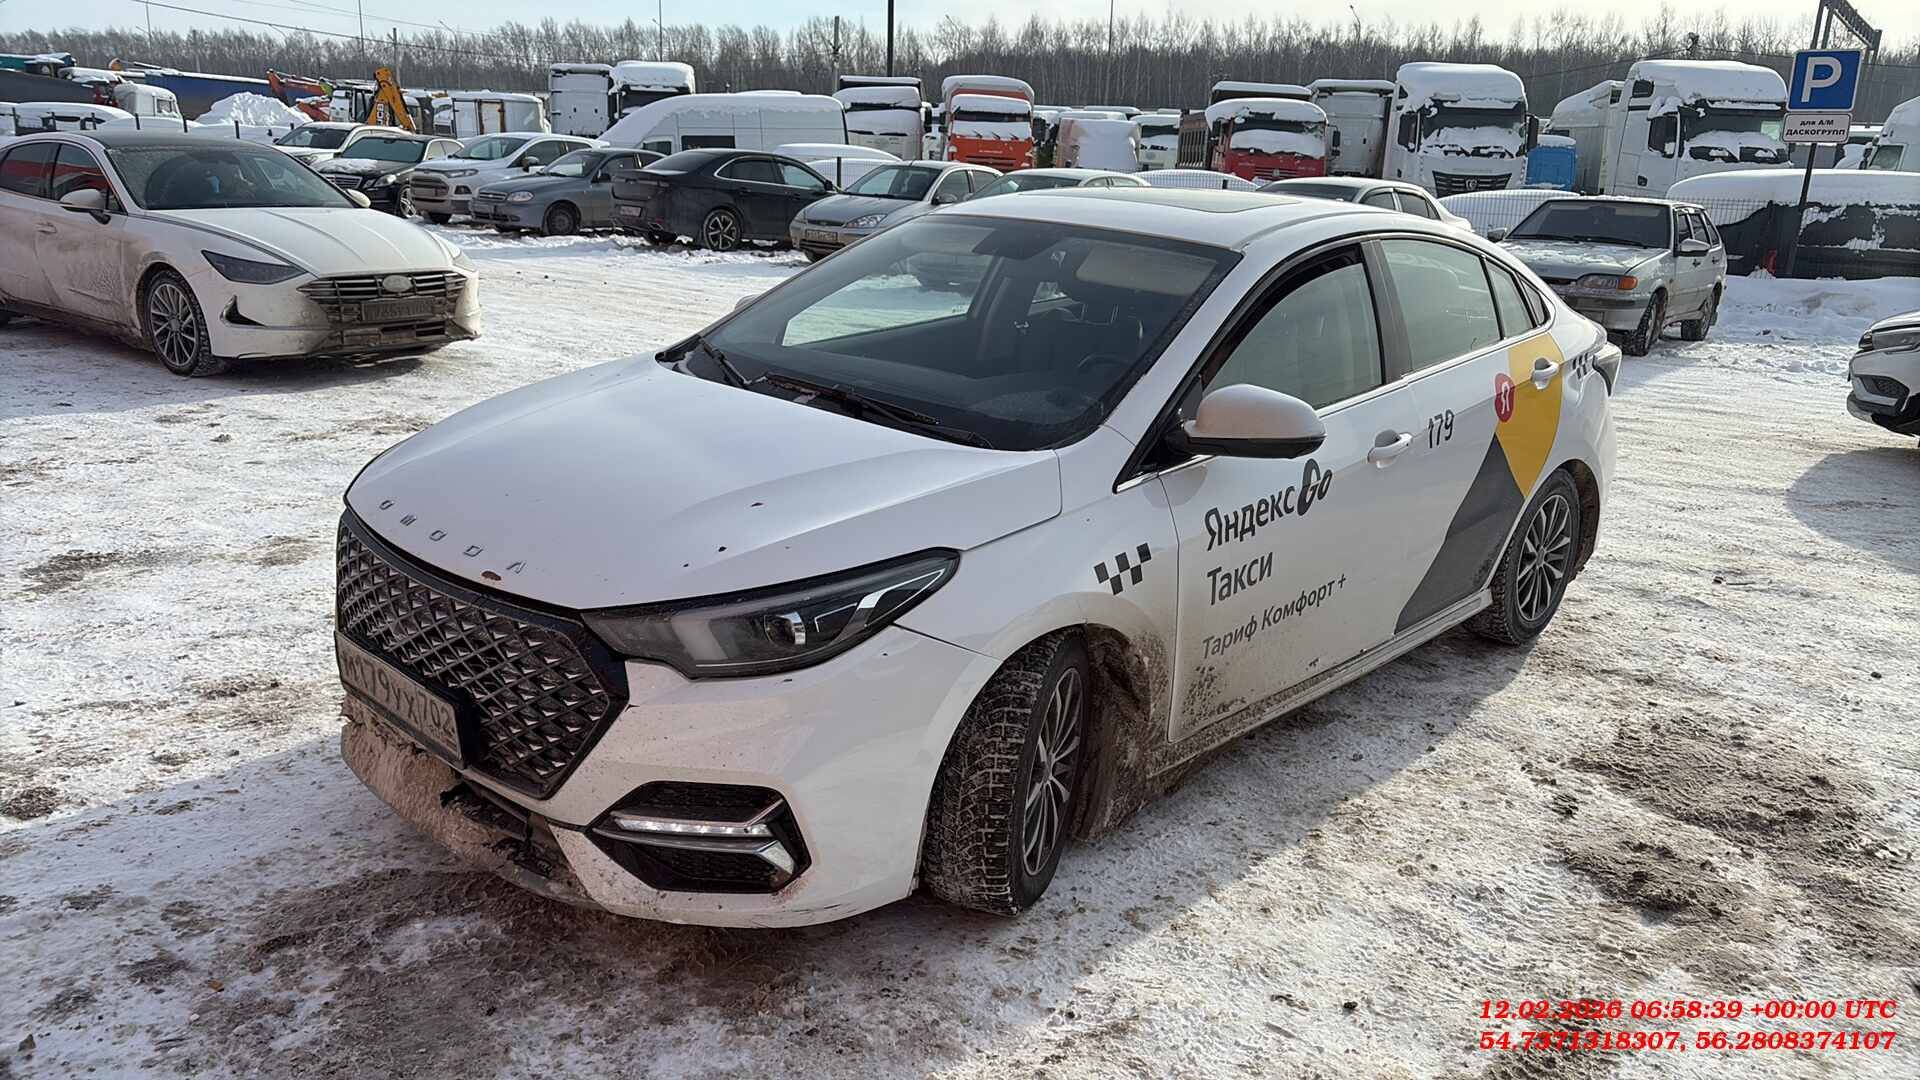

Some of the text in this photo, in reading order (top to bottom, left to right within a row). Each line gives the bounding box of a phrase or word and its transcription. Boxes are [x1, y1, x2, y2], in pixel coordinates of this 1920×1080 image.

[1801, 56, 1842, 103] P
[1428, 409, 1455, 449] 179
[1204, 458, 1333, 552] Яндекс Go
[1207, 552, 1273, 606] Такси
[1202, 616, 1258, 659] Тариф
